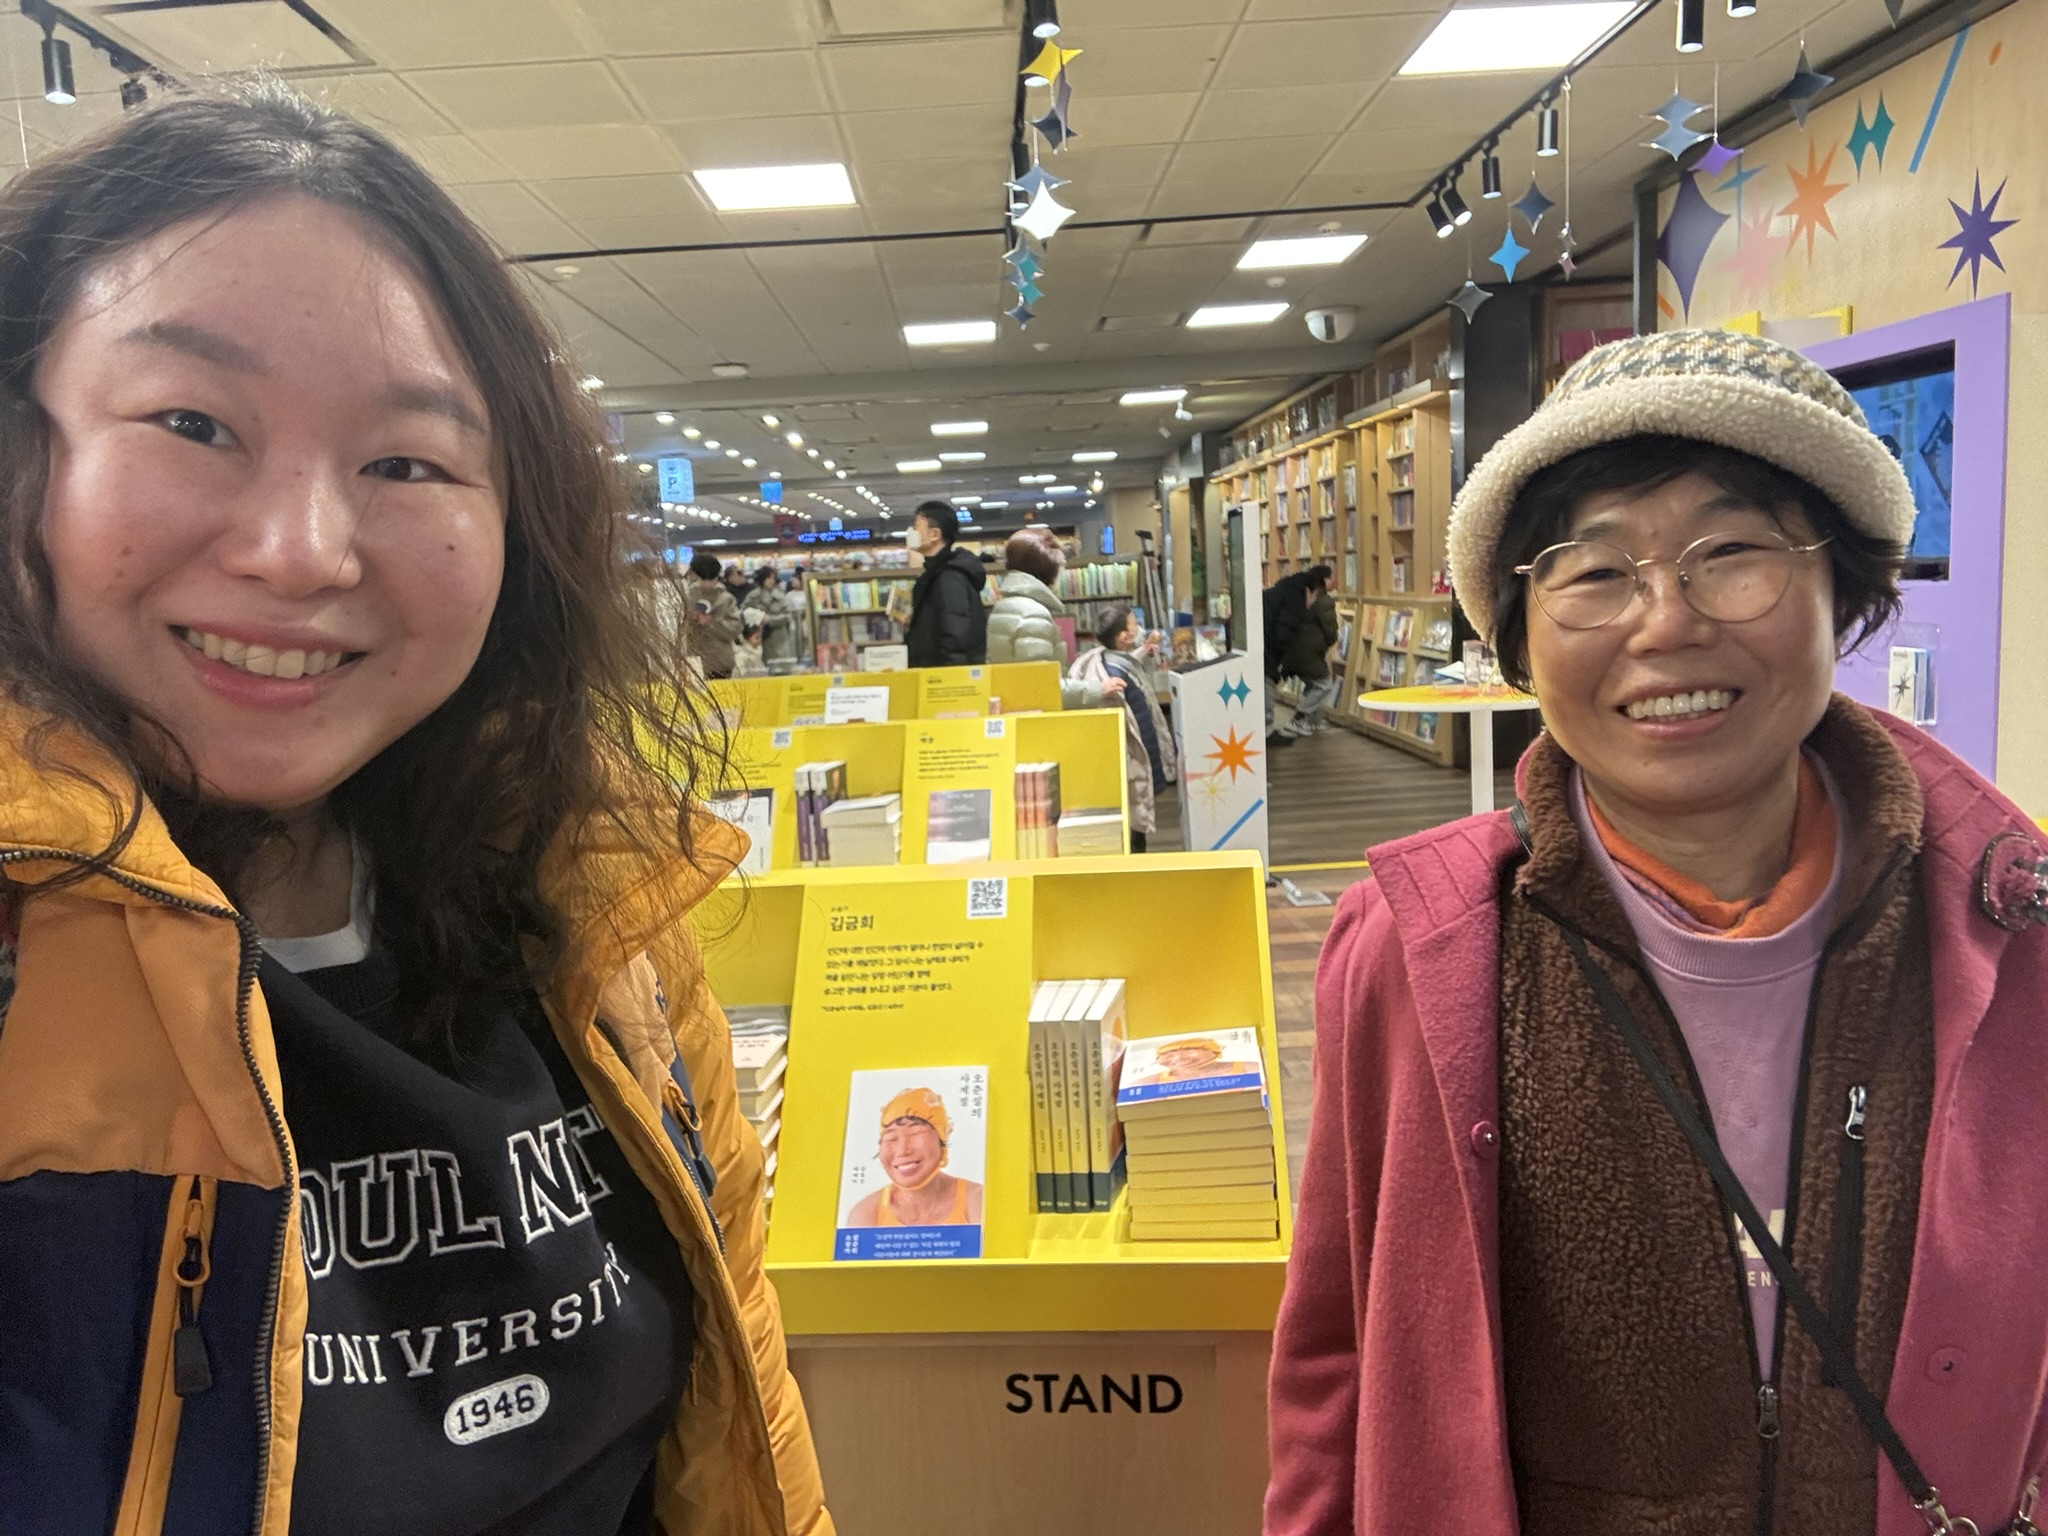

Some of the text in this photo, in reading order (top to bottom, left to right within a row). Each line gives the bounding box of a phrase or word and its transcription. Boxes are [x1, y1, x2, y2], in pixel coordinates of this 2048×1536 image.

[830, 914, 875, 932] 김금희
[455, 1383, 536, 1435] 1946
[1006, 1373, 1183, 1414] STAND
